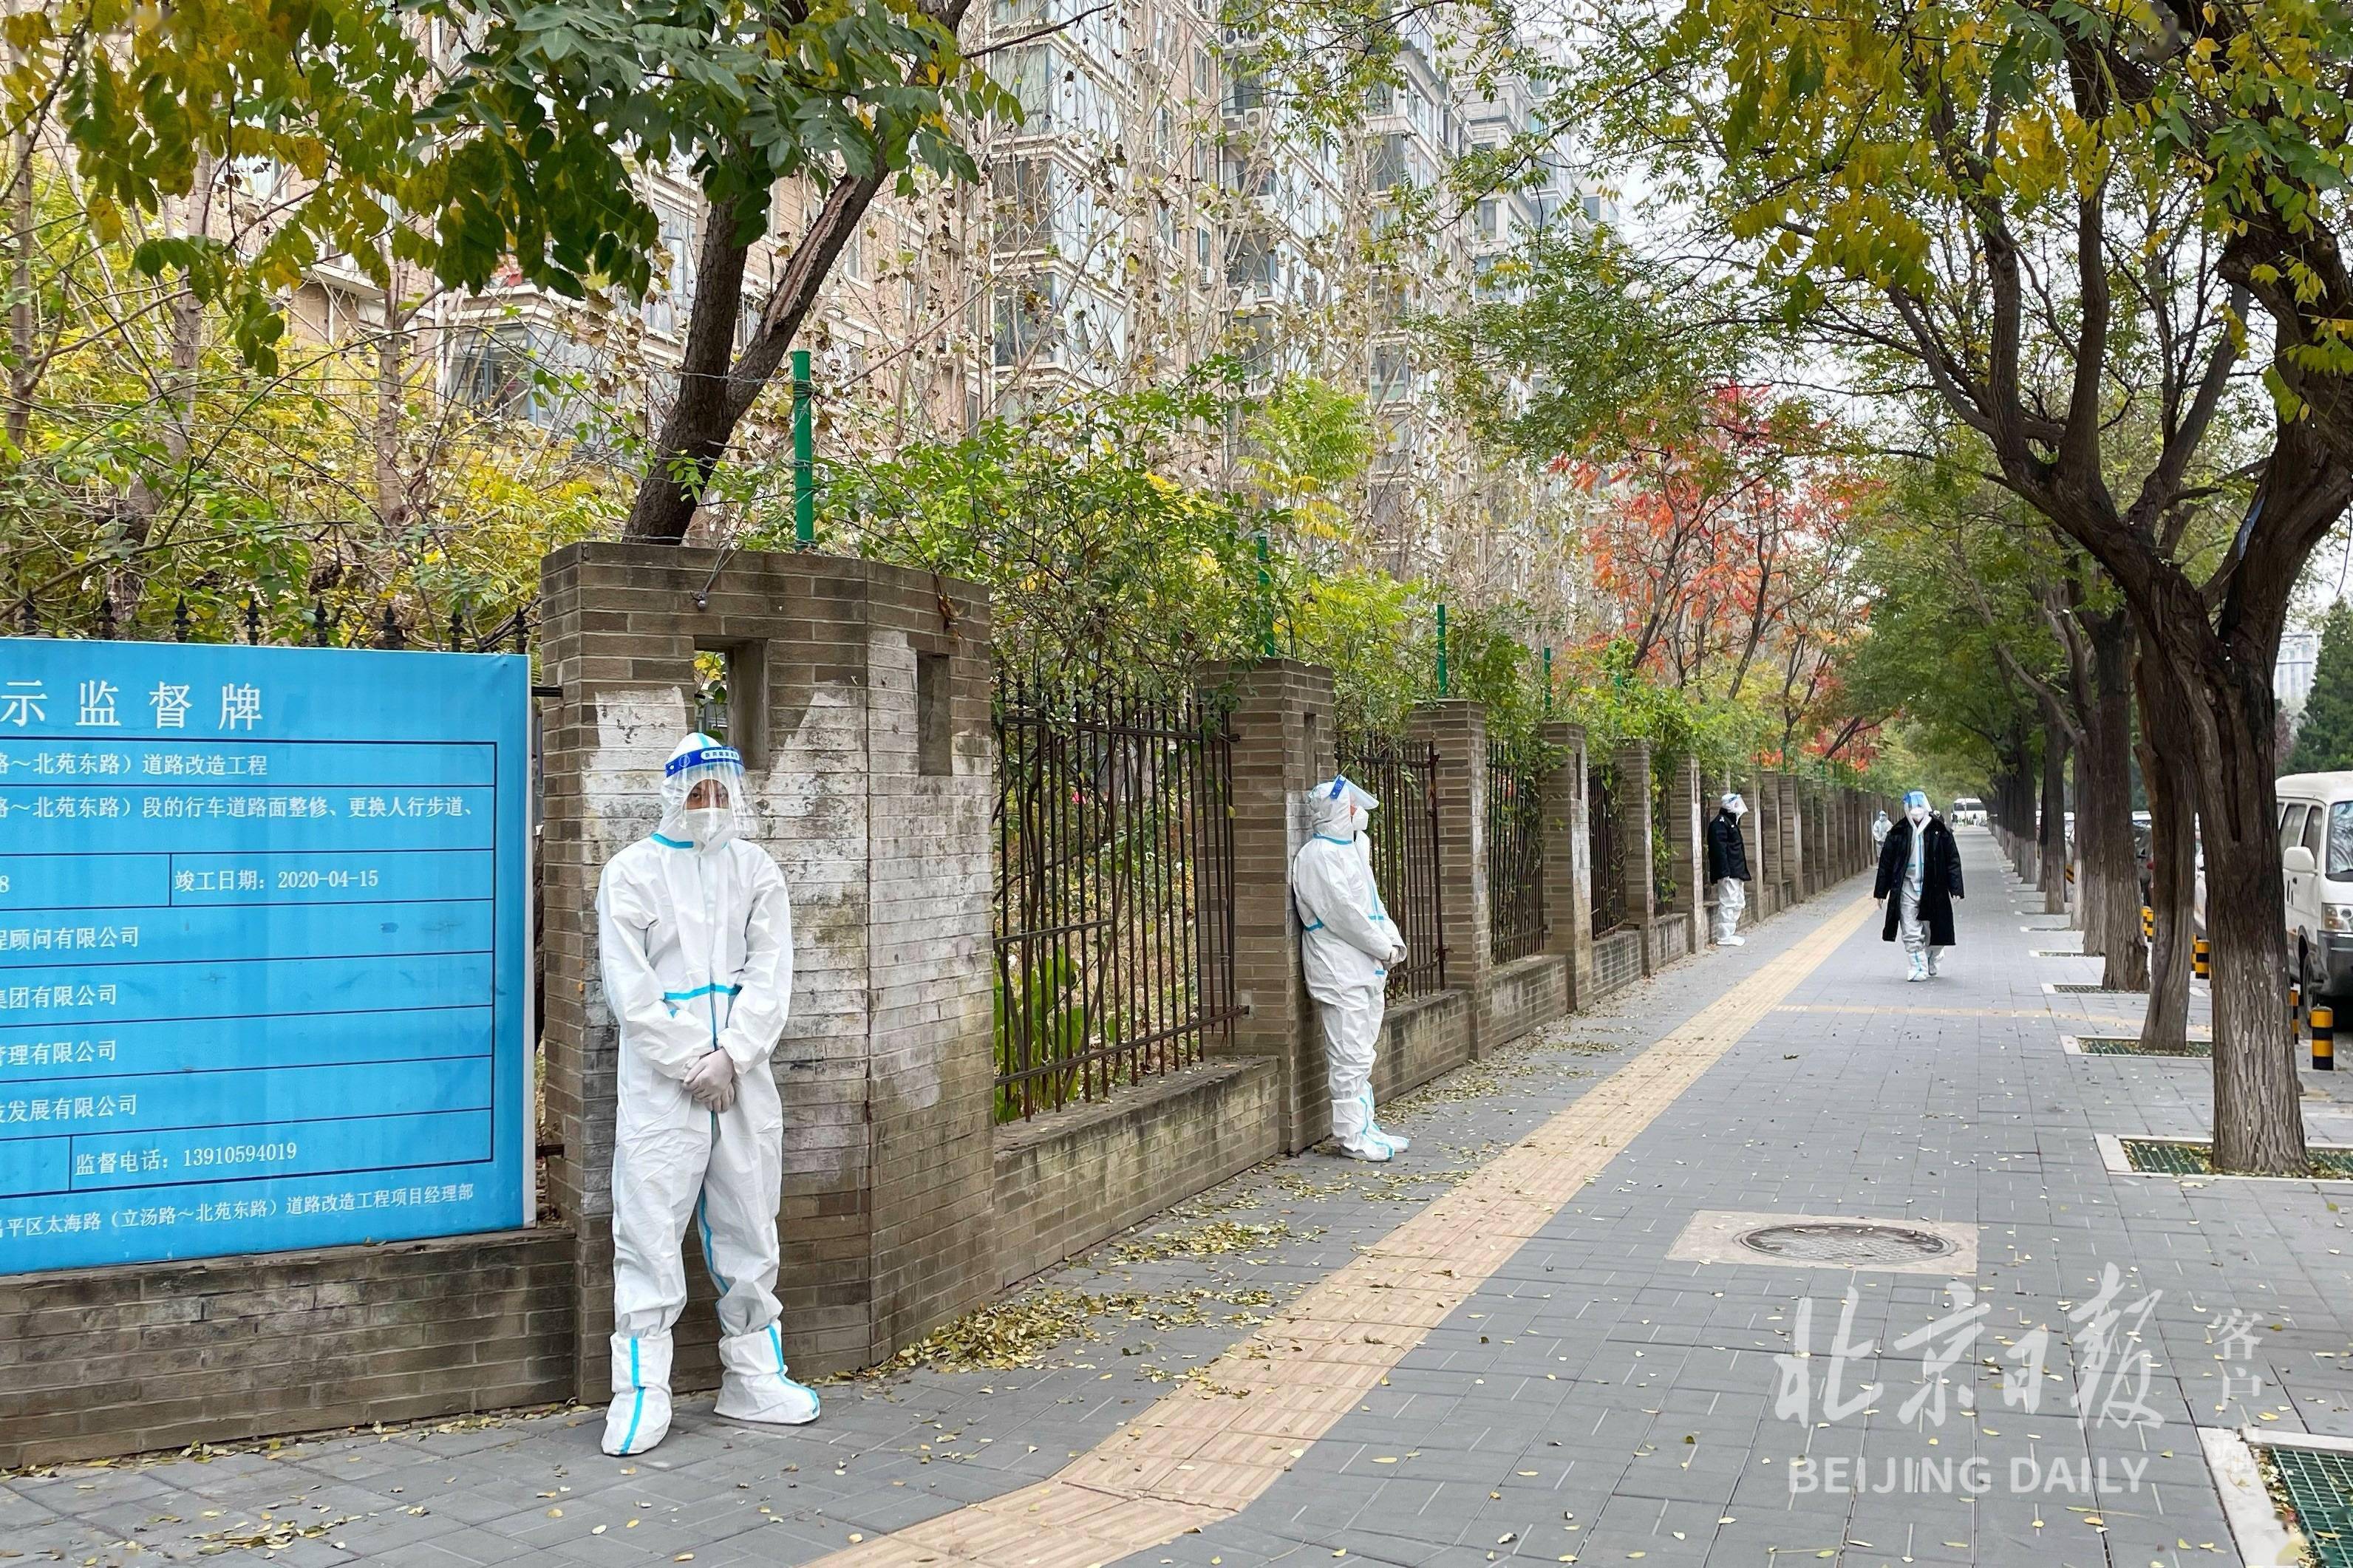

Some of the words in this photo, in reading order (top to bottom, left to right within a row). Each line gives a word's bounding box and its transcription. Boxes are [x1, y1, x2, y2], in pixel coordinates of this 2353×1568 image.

[0, 679, 262, 730] 示监督牌
[0, 1094, 137, 1124] 发展有限公司
[0, 1182, 474, 1238] 平区太海路（立汤路～北苑东路）道路改造工程项目经理部
